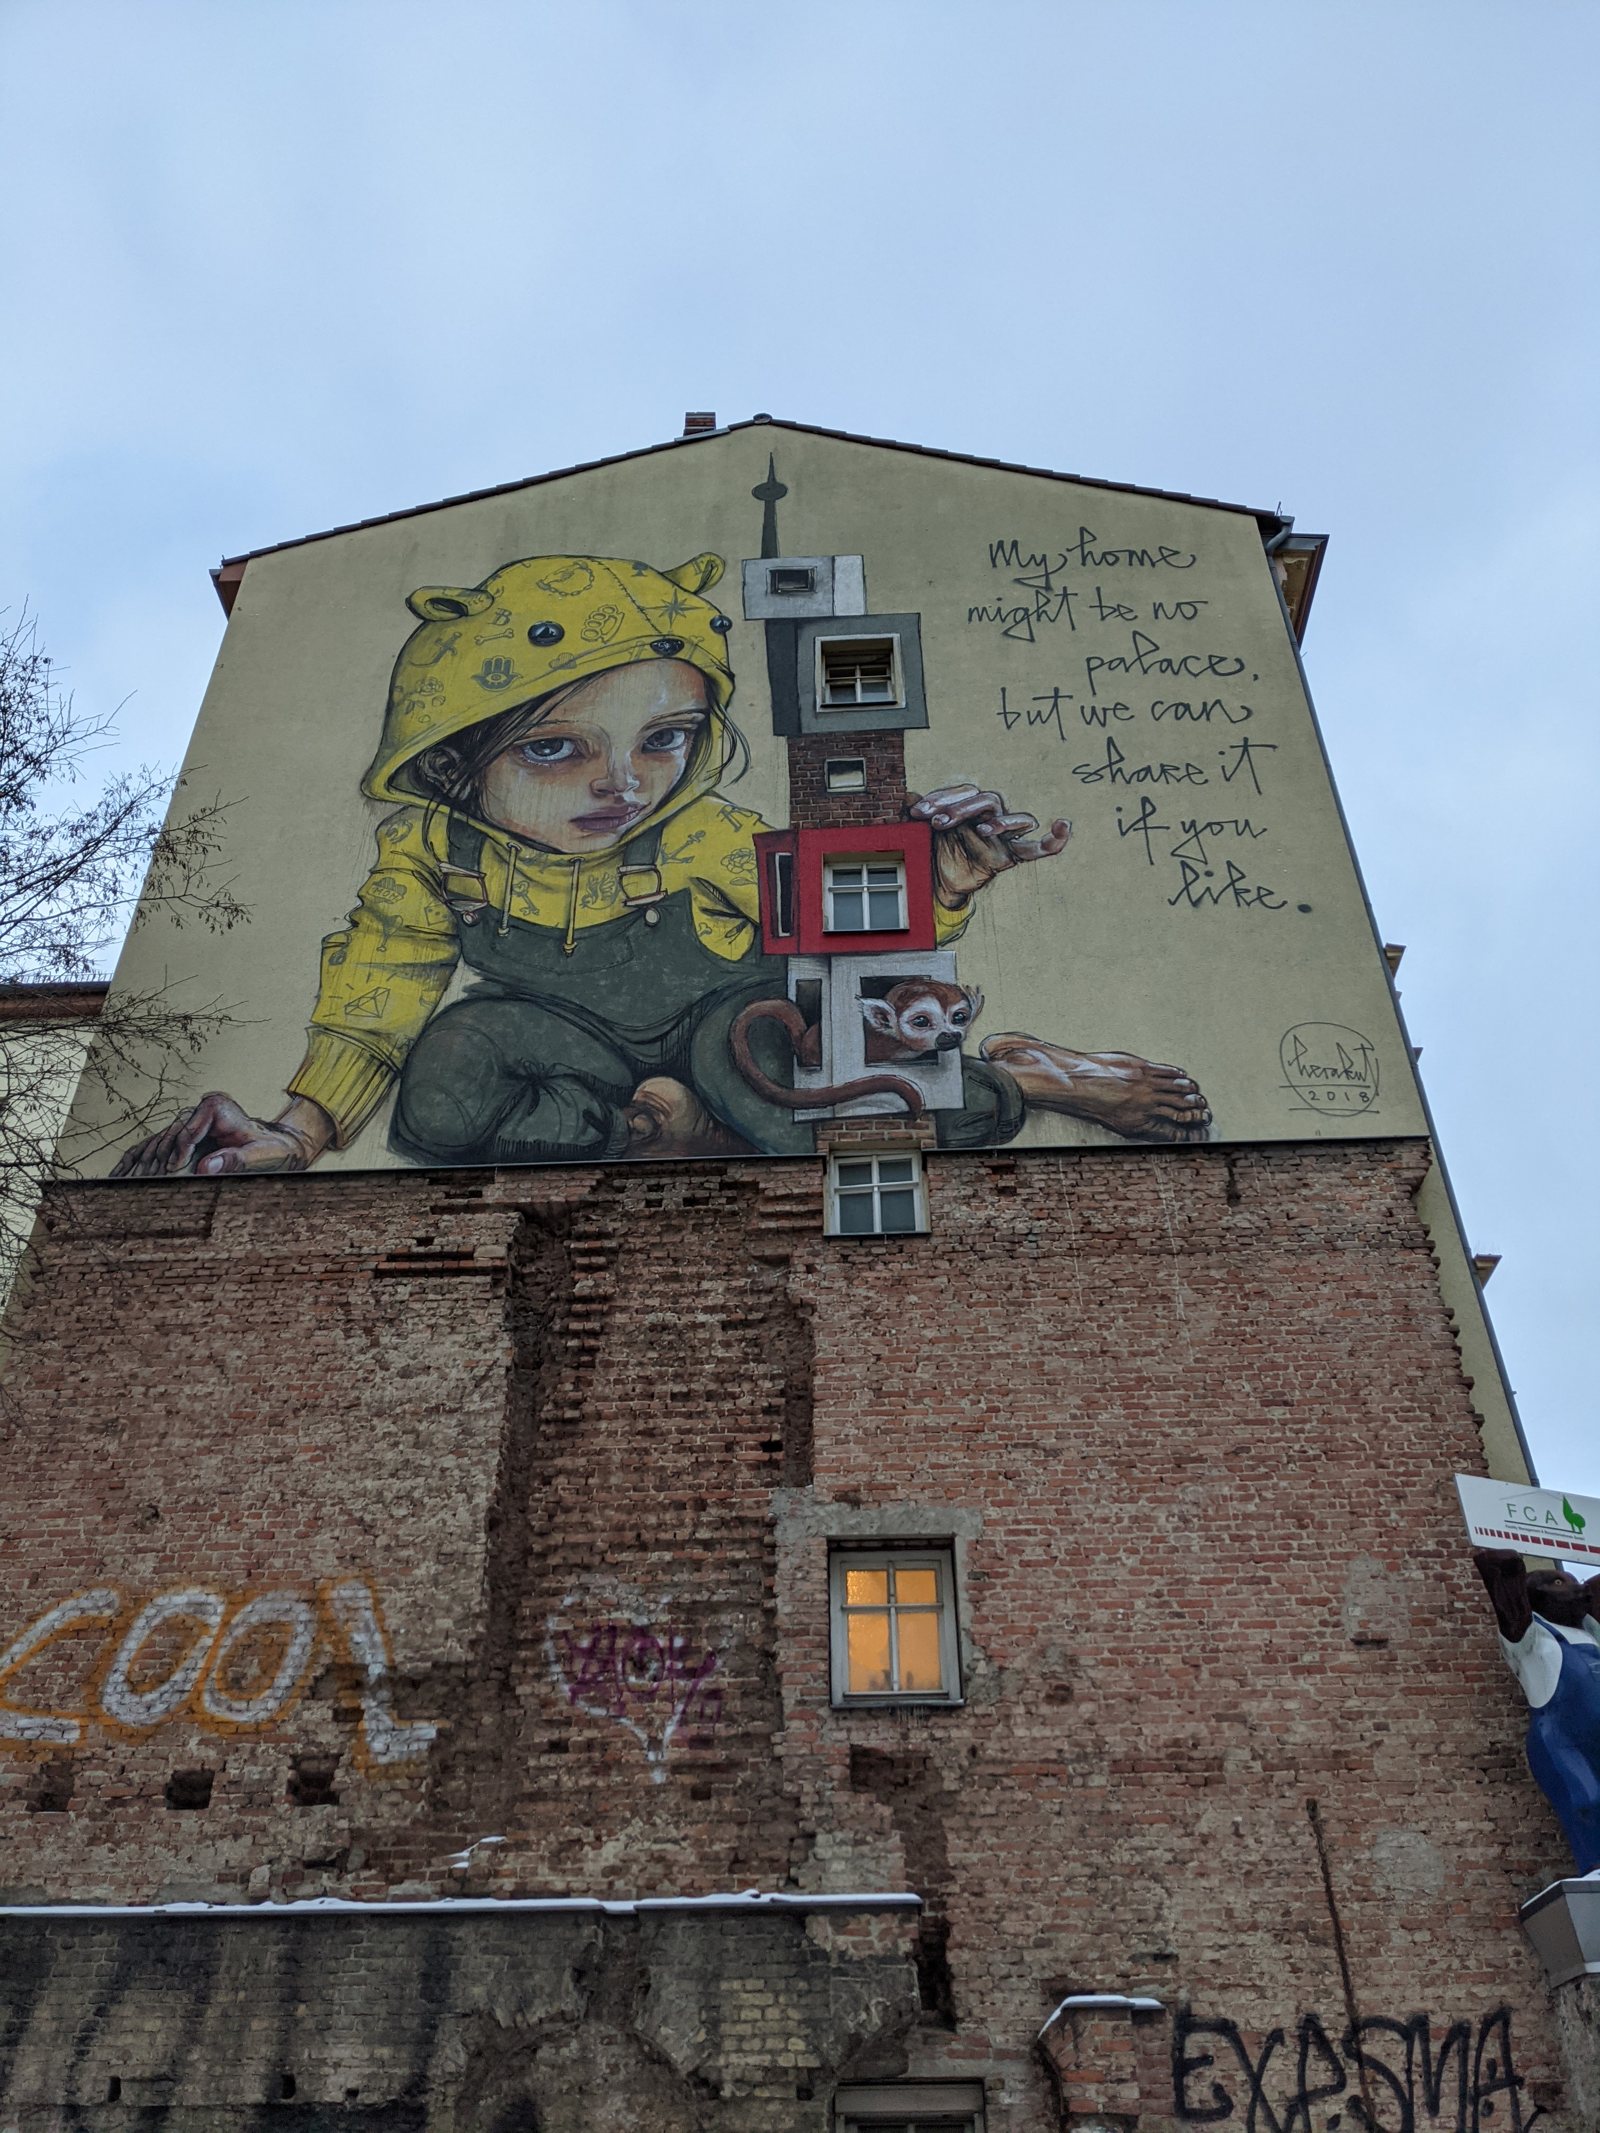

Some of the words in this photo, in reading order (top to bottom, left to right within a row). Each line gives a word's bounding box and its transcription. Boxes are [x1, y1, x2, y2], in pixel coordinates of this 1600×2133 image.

[1066, 527, 1197, 568] home
[968, 586, 1078, 642] might
[1089, 586, 1138, 621] be
[1153, 600, 1209, 621] no
[997, 687, 1074, 741] but
[1081, 700, 1135, 728] we
[1151, 698, 1254, 724] can
[1072, 736, 1209, 785] share
[1218, 736, 1279, 795] it
[1115, 796, 1170, 866] if
[1170, 818, 1268, 865] you
[1168, 860, 1313, 914] like.
[1308, 1090, 1370, 1103] 2018
[1506, 1502, 1559, 1526] FCA
